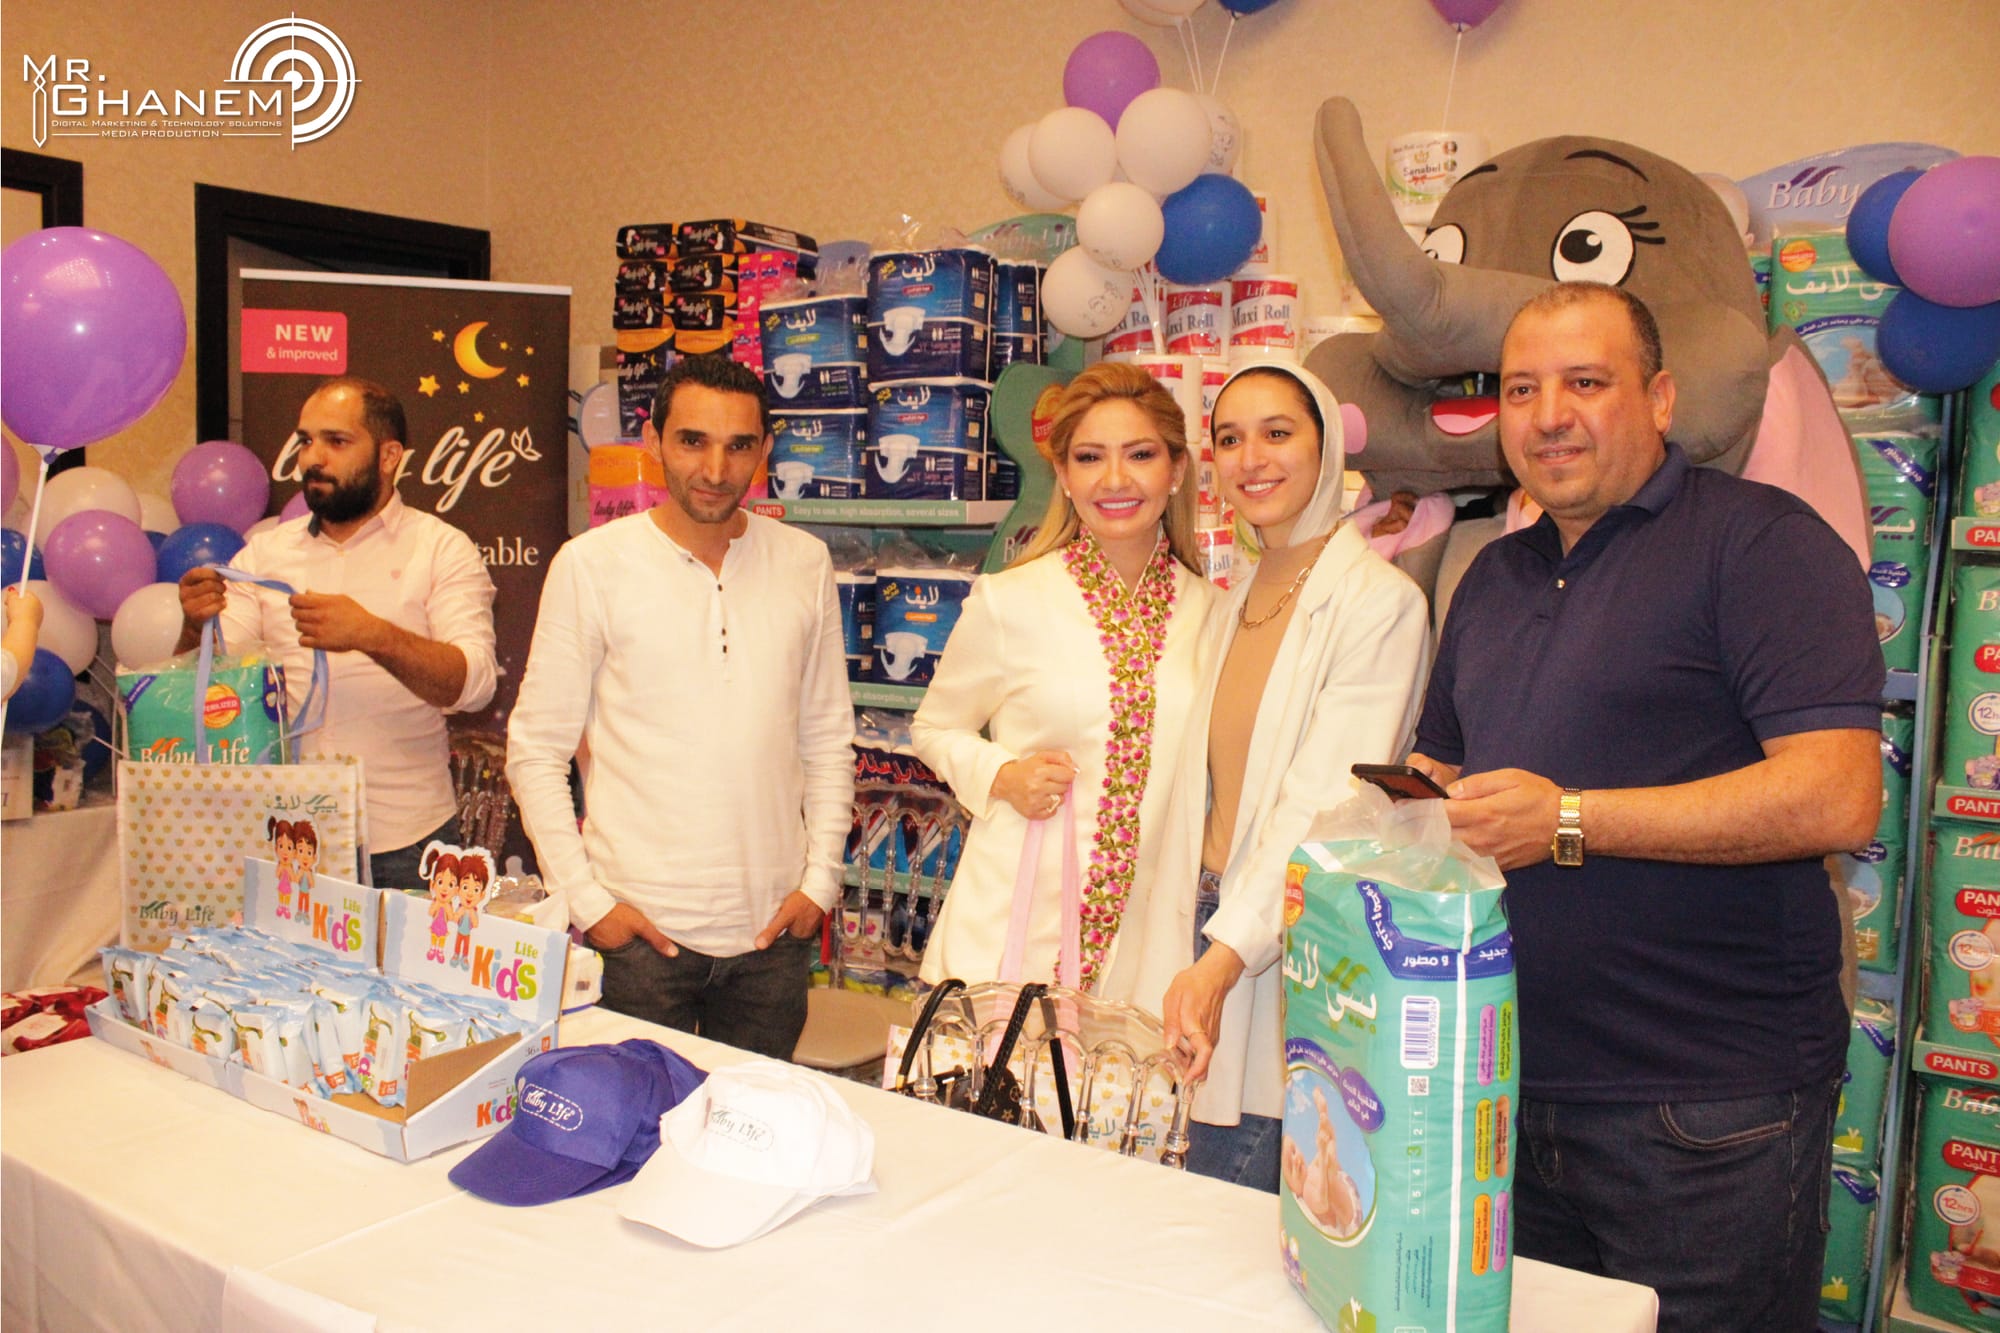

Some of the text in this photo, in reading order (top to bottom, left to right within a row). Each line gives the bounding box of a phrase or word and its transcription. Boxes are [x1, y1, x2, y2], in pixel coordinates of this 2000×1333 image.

[1263, 304, 1290, 319] Roll
[275, 323, 334, 342] NEW
[266, 346, 338, 362] & improved
[420, 425, 518, 513] life
[755, 507, 783, 517] PANTS
[906, 508, 936, 517] several
[937, 508, 960, 517] sizes
[207, 737, 251, 764] Life
[138, 901, 216, 926] Baby Life
[343, 897, 362, 915] Life
[312, 902, 363, 953] Kids
[514, 940, 538, 959] Life
[1478, 948, 1509, 961] جديد
[1402, 954, 1439, 968] مطور
[470, 944, 537, 1002] Kids
[1932, 1055, 1991, 1076] PANTS
[524, 1089, 576, 1121] Baby Life
